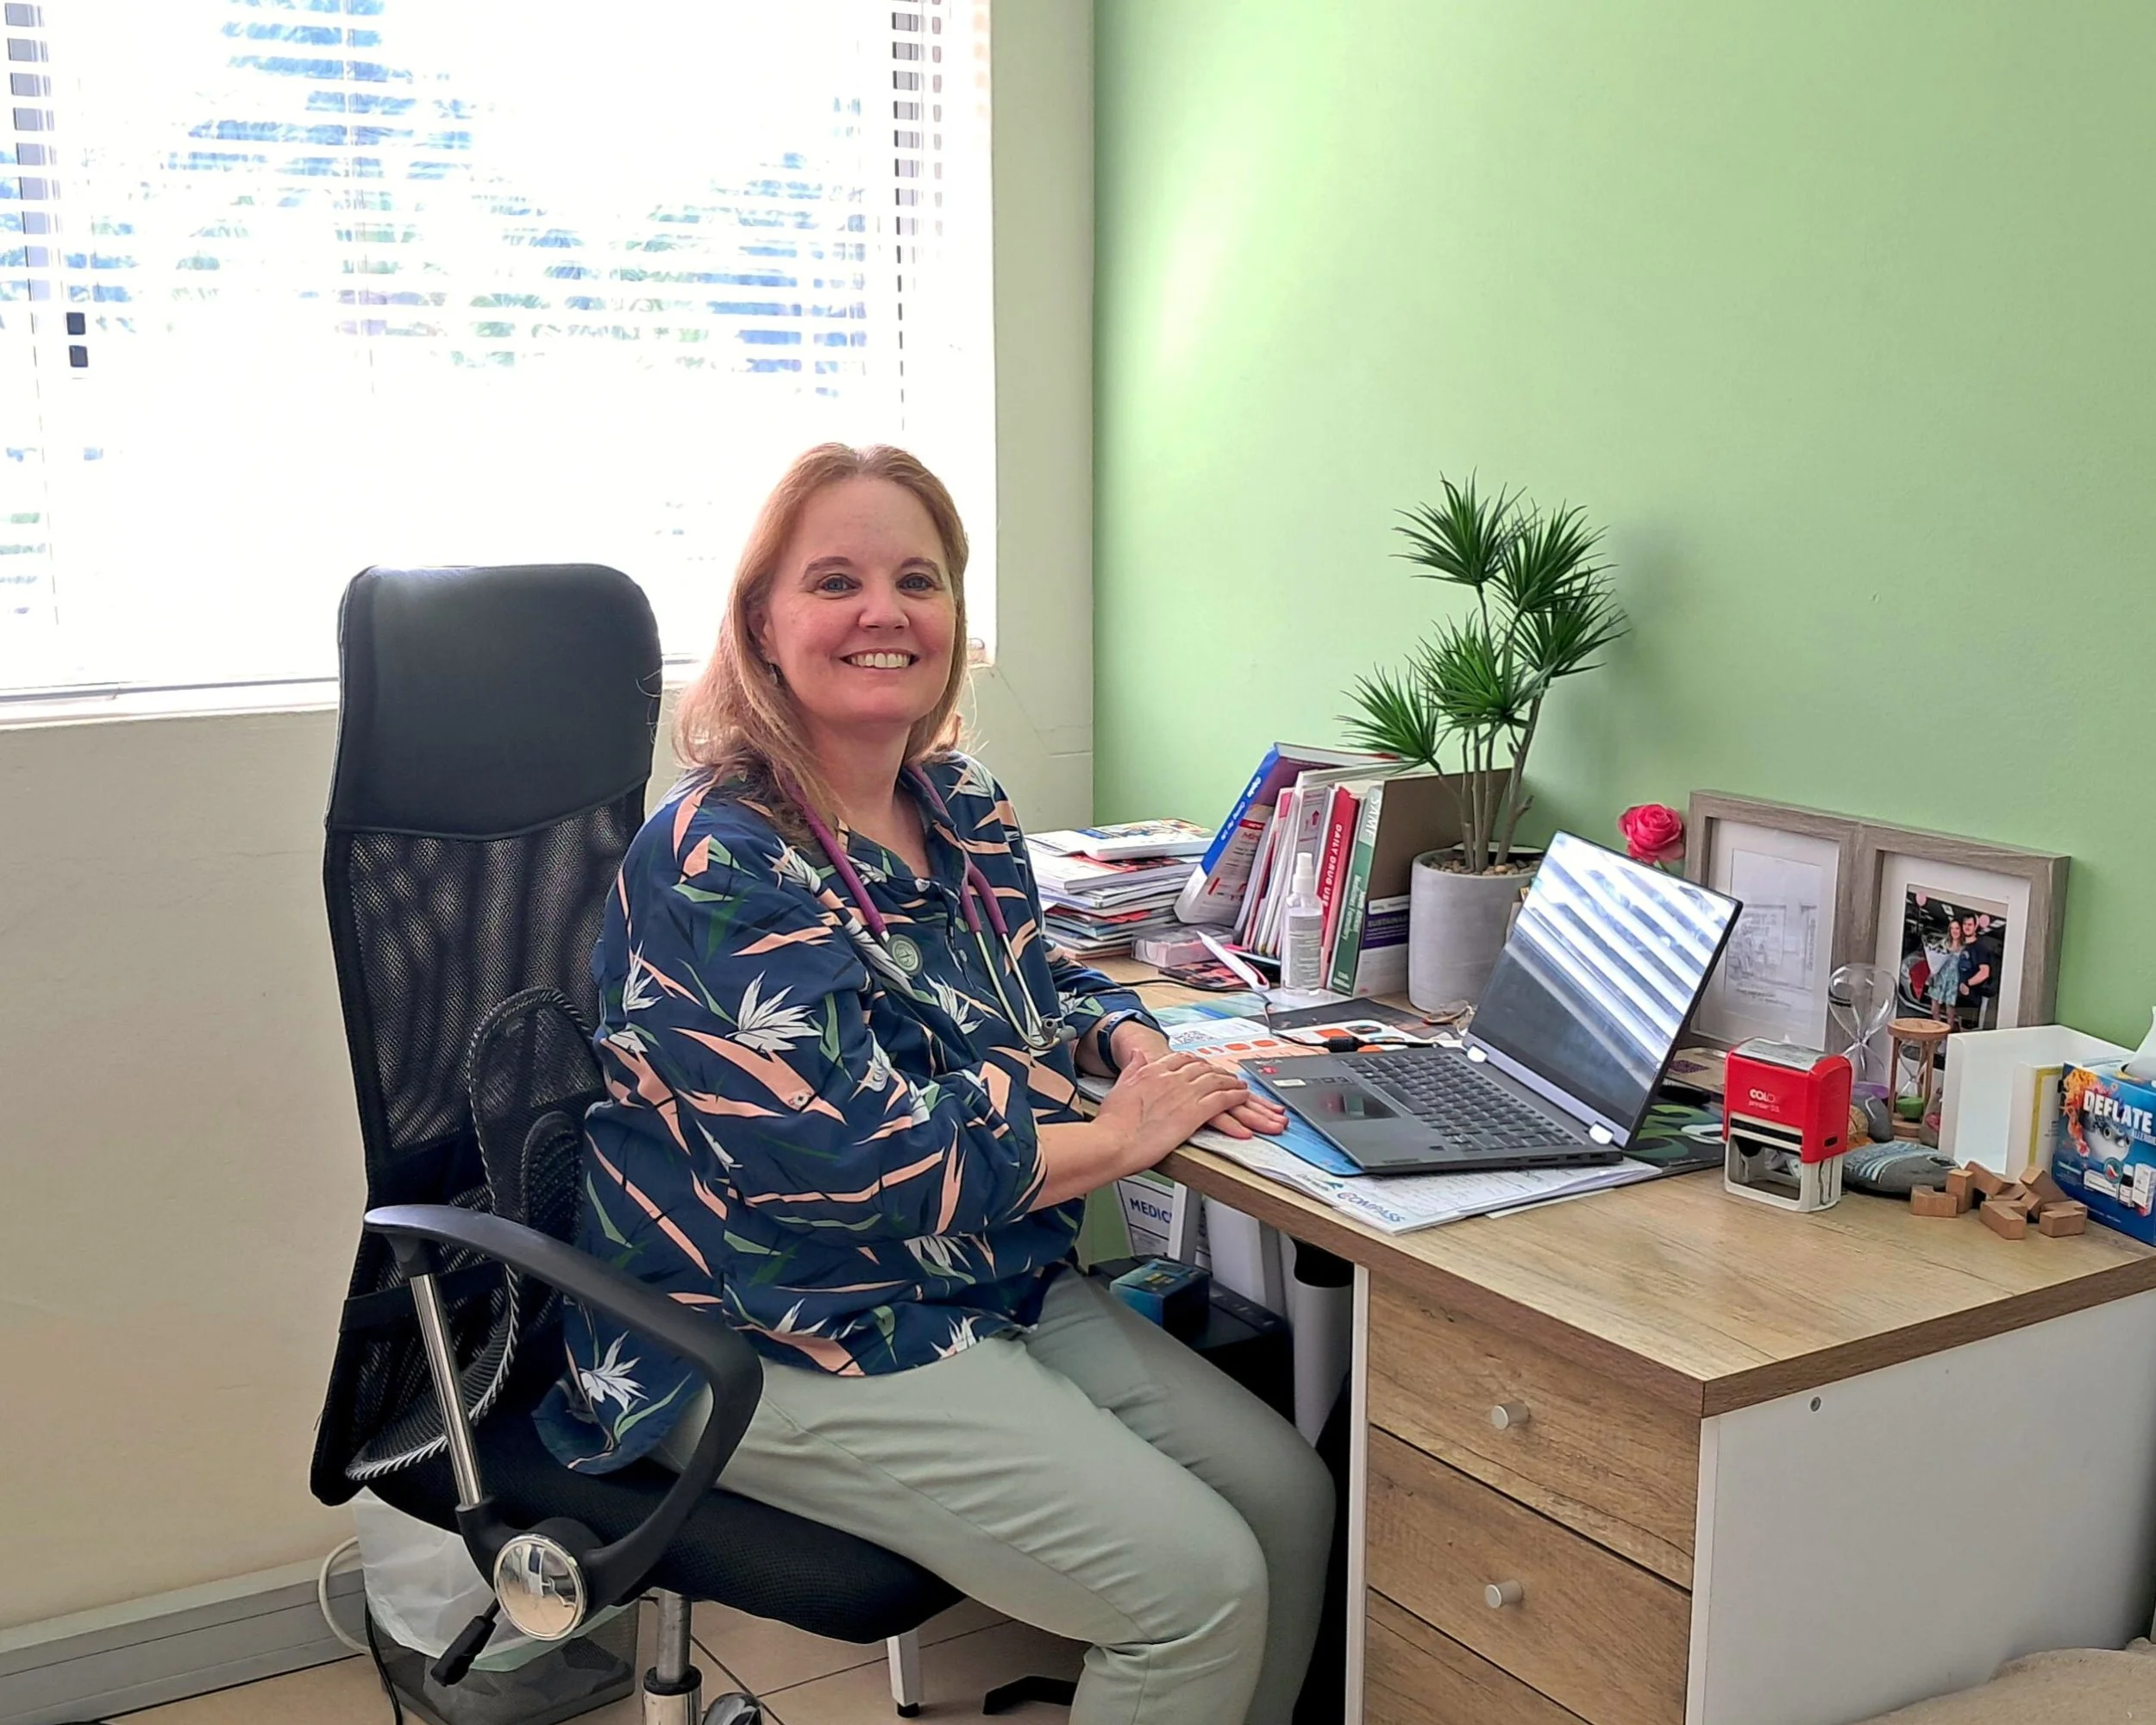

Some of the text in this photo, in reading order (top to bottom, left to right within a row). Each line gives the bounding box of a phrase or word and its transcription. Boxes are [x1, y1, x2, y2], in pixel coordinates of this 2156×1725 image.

[1364, 796, 1381, 837] SAMF
[1331, 824, 1342, 855] DAILY
[1326, 854, 1338, 886] DRUG
[1749, 1088, 1778, 1103] COLO
[2083, 1088, 2153, 1134] DEFLATE
[1337, 1192, 1406, 1222] COMPASS
